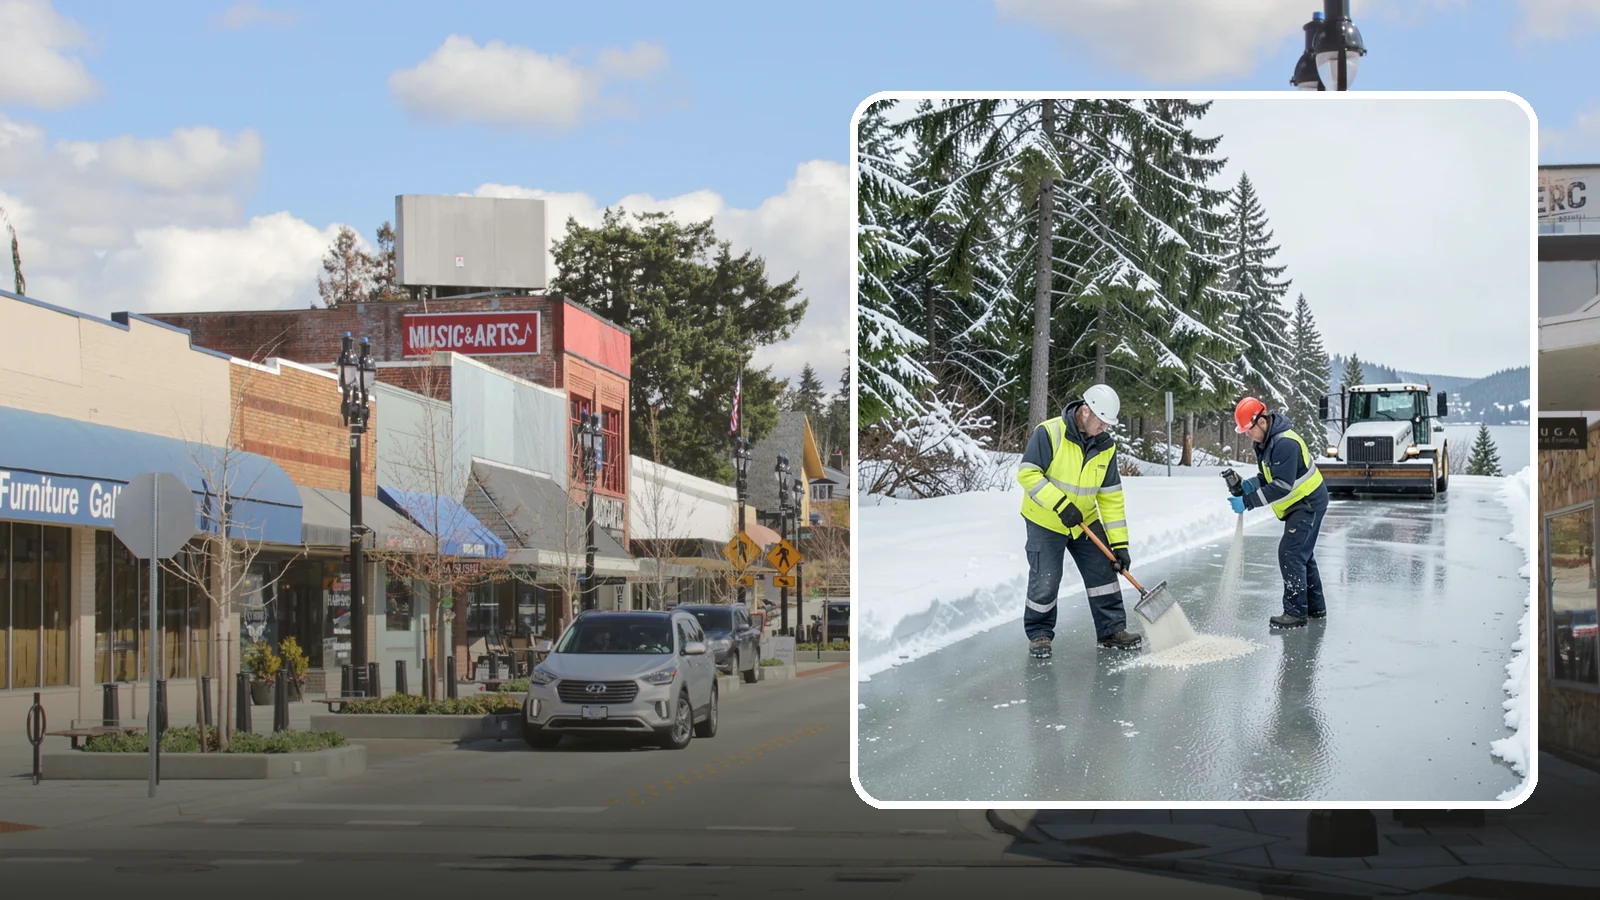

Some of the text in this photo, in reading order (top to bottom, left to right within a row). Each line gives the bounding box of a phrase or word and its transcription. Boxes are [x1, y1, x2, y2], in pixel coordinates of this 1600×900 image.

[409, 323, 519, 348] MUSIC&ARTS
[1540, 427, 1577, 437] UGA
[0, 471, 122, 519] Furniture Gal
[453, 563, 479, 574] SUSHI
